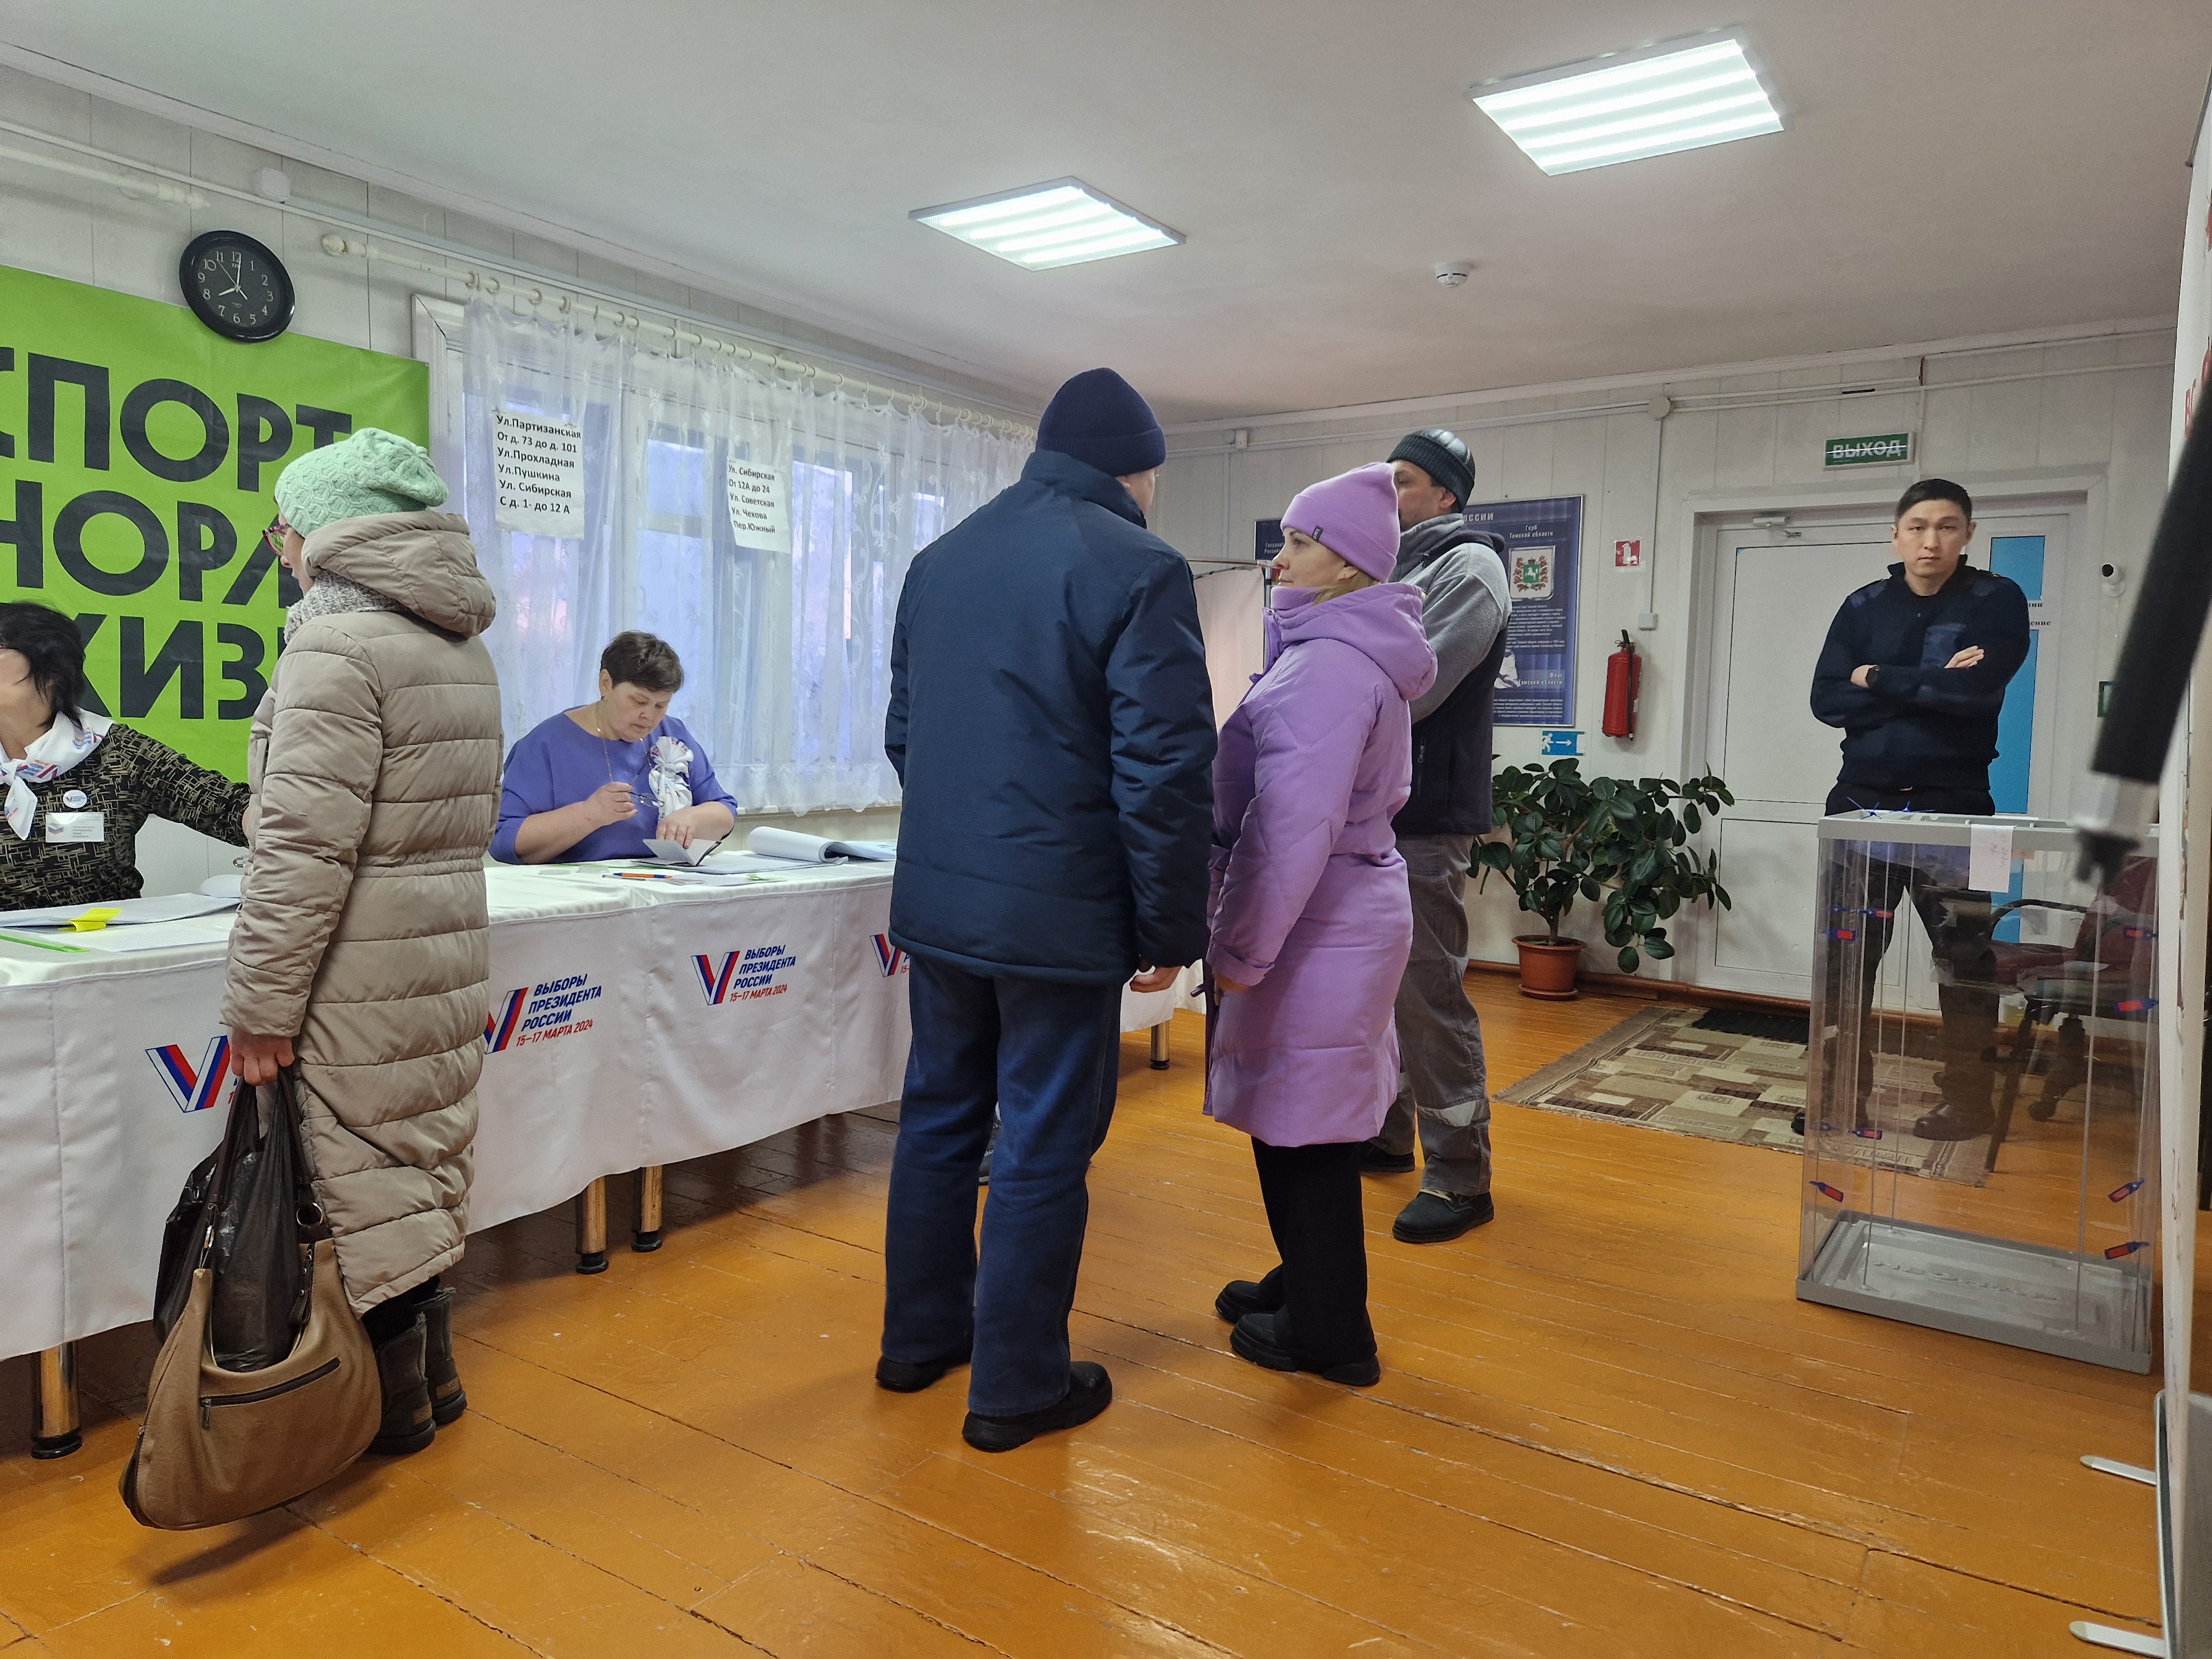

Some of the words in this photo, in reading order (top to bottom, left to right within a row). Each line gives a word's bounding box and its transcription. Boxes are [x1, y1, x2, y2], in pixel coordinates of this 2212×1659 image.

[216, 251, 224, 263] 11
[232, 251, 241, 262] 12
[204, 258, 216, 271] 10
[251, 260, 255, 271] 1
[197, 272, 205, 283] 9
[262, 275, 268, 286] 2
[203, 289, 211, 300] 8
[267, 291, 274, 302] 3
[218, 305, 226, 317] 7
[262, 305, 268, 316] 4
[233, 313, 241, 324] 6
[250, 314, 256, 325] 5
[0, 347, 352, 492] ПОРТ
[497, 415, 581, 439] Ул.Партизанская
[498, 431, 508, 441] От
[510, 436, 519, 445] д.
[522, 436, 533, 446] 73
[535, 440, 547, 449] до
[550, 443, 559, 451] д.
[562, 442, 577, 453] 101
[1833, 440, 1901, 459] ВЫХОД
[498, 446, 575, 468] Ул.Прохладная
[498, 463, 560, 482] Ул.Пушкина
[728, 464, 737, 474] Ул.
[739, 467, 775, 481] Сибирская
[499, 479, 515, 490] Ул.
[519, 482, 571, 498] Сибирская
[752, 485, 760, 493] до
[762, 486, 770, 494] 24
[500, 496, 507, 505] С
[509, 499, 519, 509] д.
[534, 503, 547, 512] до
[550, 503, 561, 513] 12
[564, 505, 570, 514] А
[729, 492, 740, 502] Ул.
[742, 495, 775, 508] Советская
[731, 507, 741, 516] Ул.
[743, 509, 768, 519] Чехова
[733, 520, 775, 534] Пер.Южный
[744, 945, 786, 960] ВЫБОРЫ
[738, 956, 796, 974] ПРЕЗИДЕНТА
[534, 973, 588, 997] ВЫБОРЫ
[733, 974, 773, 989] РОССИИ
[749, 988, 773, 999] МАРТА
[773, 984, 787, 995] 2024
[528, 985, 602, 1014] ПРЕЗИДЕНТА
[521, 1009, 572, 1032] РОССИИ
[542, 1024, 572, 1040] МАРТА
[573, 1019, 593, 1034] 2024
